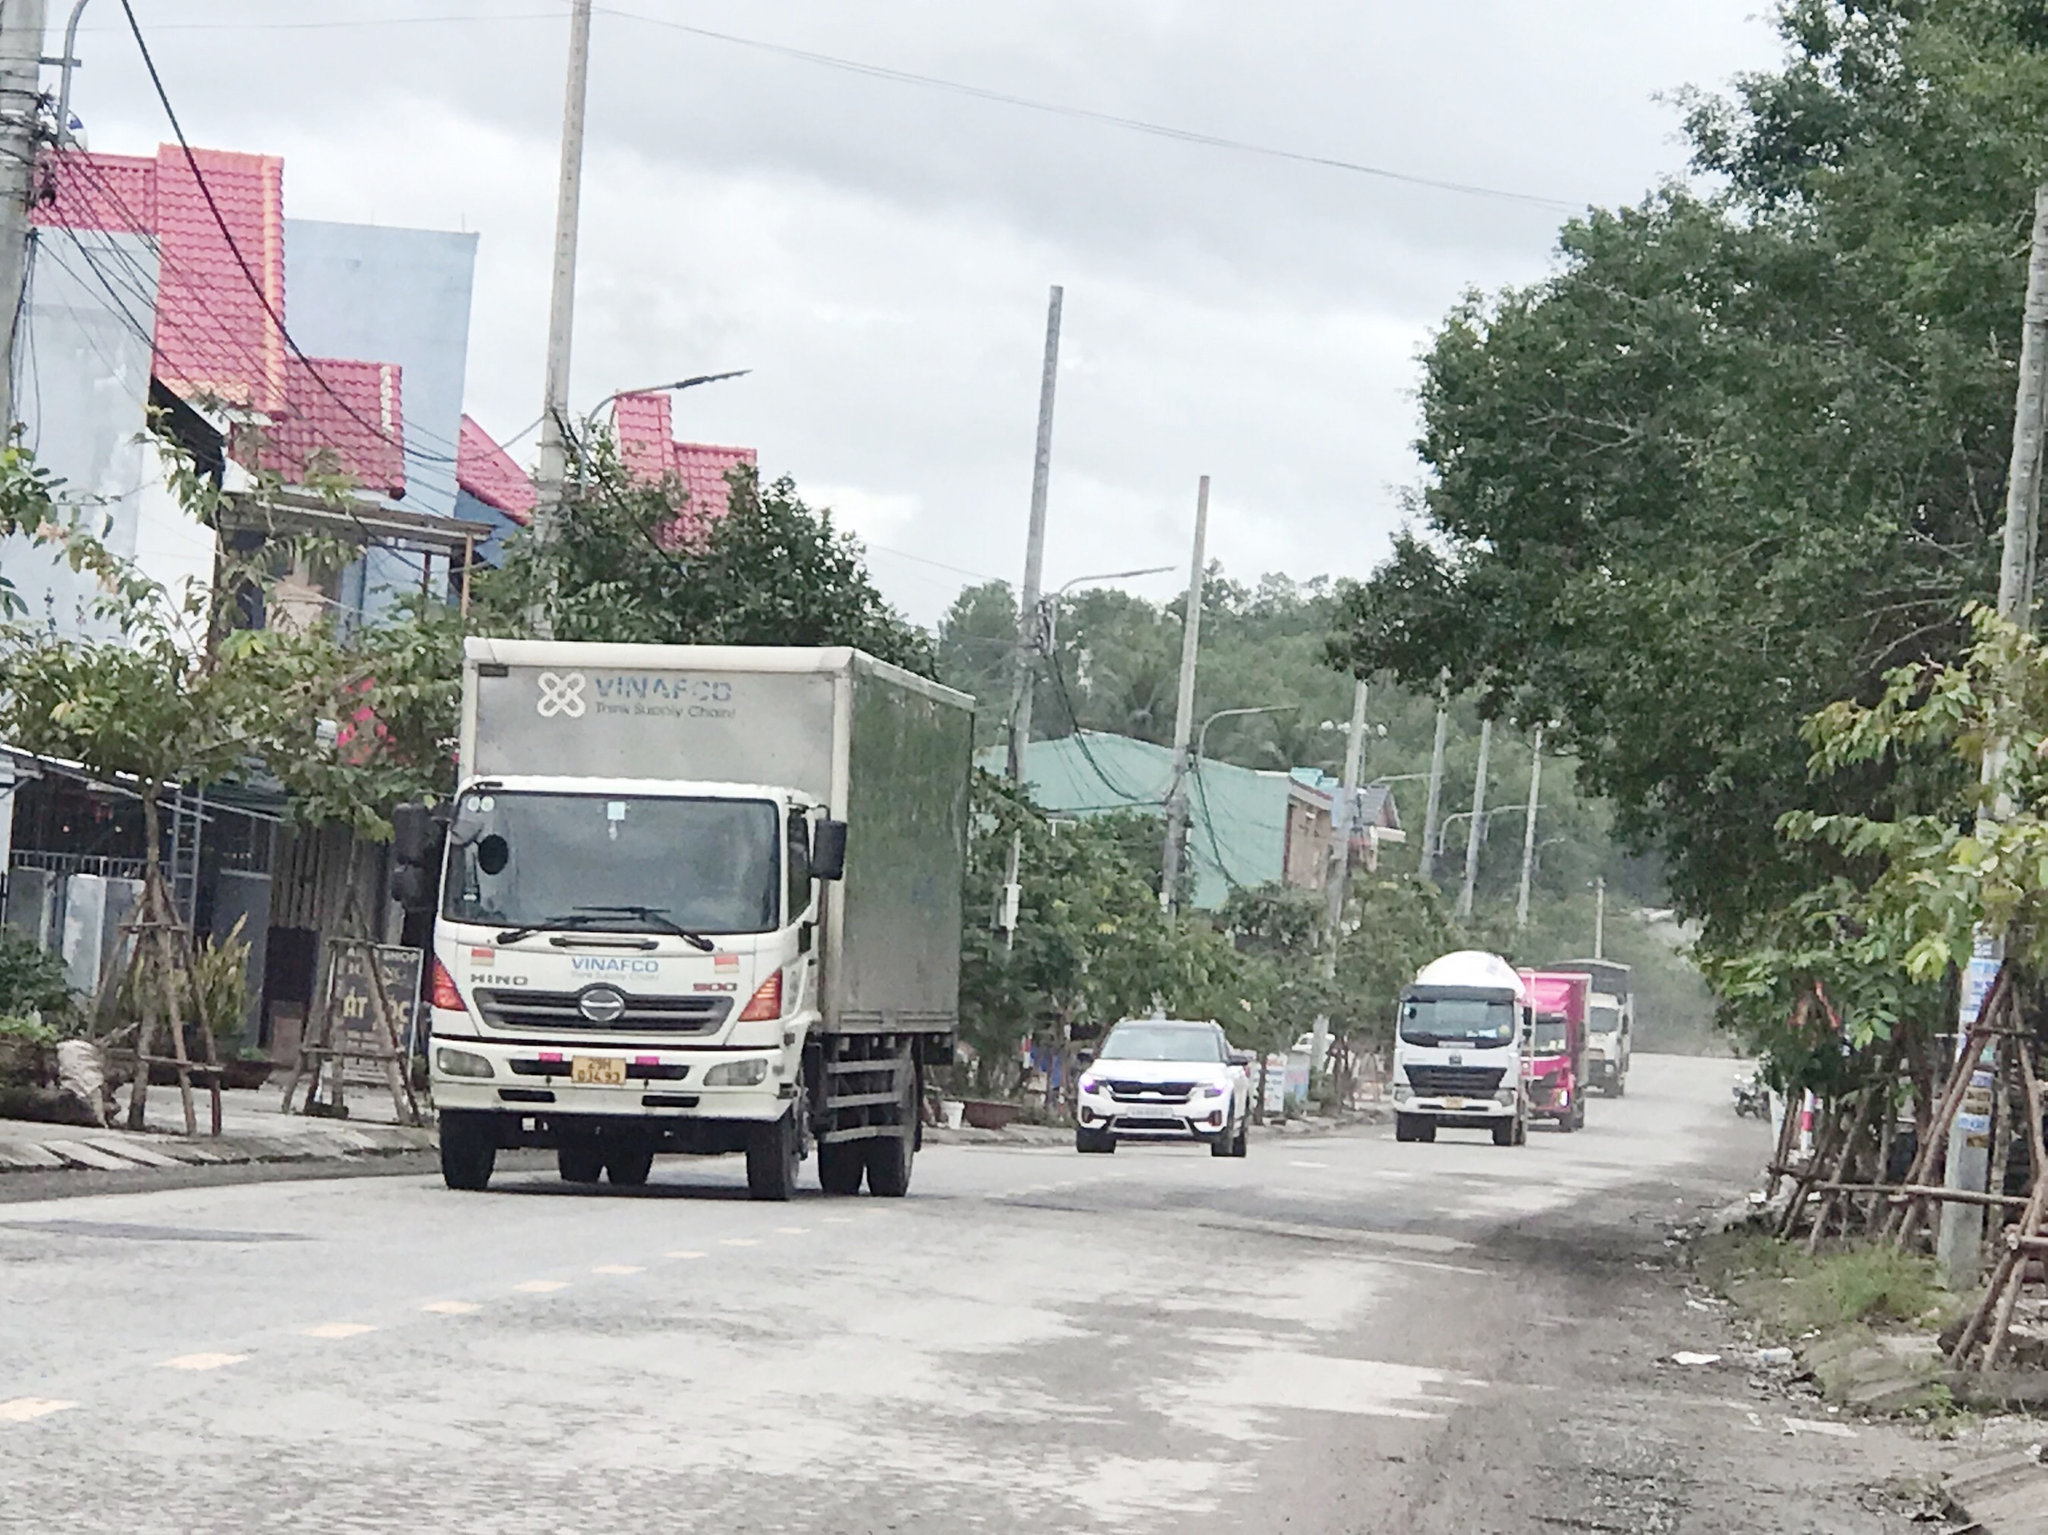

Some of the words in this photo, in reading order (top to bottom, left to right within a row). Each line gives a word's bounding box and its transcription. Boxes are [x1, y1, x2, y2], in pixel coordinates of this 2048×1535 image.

[595, 676, 732, 701] VINAFCO
[572, 957, 660, 973] VINAFCO
[471, 974, 528, 985] HINO
